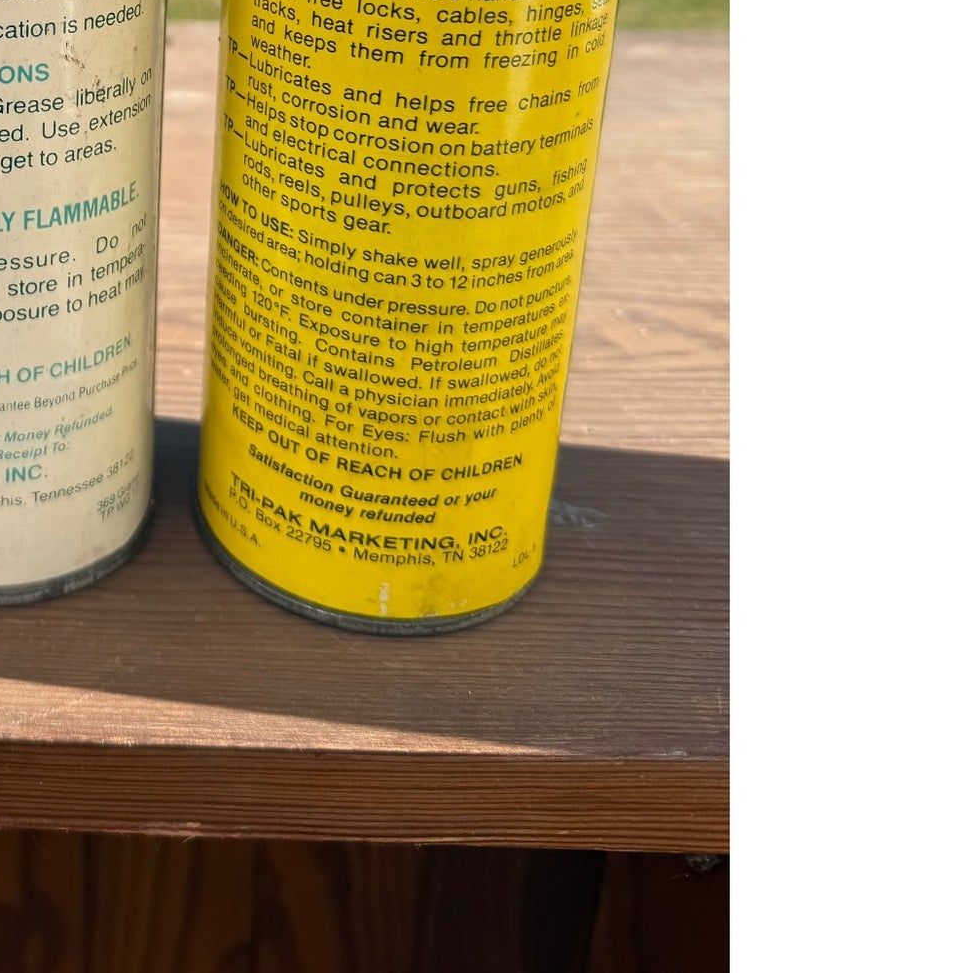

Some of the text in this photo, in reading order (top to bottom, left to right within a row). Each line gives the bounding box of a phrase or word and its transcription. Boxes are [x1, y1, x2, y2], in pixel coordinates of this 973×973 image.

[63, 16, 77, 34] is
[84, 0, 144, 30] needed.
[23, 181, 139, 230] FLAMMABLE.
[220, 179, 239, 207] HOW
[242, 198, 257, 220] TO
[261, 212, 294, 238] USE:
[298, 230, 357, 260] Simply
[362, 248, 418, 268] shake
[424, 256, 465, 271] well,
[471, 253, 515, 271] spray
[17, 366, 44, 383] OF
[34, 391, 75, 409] Beyond
[79, 373, 120, 398] Purchase
[4, 429, 50, 443] Money
[232, 403, 523, 481] KEEP OUT OF REACH OF CHILDREN
[5, 464, 48, 483] INC.
[31, 473, 104, 504] Tennessee
[248, 443, 497, 507] Satisfaction Guaranteed or your
[231, 471, 302, 527] TRI-PAK
[310, 519, 460, 550] MARKETING,
[468, 526, 508, 545] INC.
[299, 491, 436, 523] money refunded
[228, 487, 250, 513] P.O.
[256, 508, 280, 532] Box
[286, 525, 331, 551] 22795
[354, 547, 435, 566] Memphis,
[443, 550, 464, 563] TN
[469, 538, 508, 559] 38122
